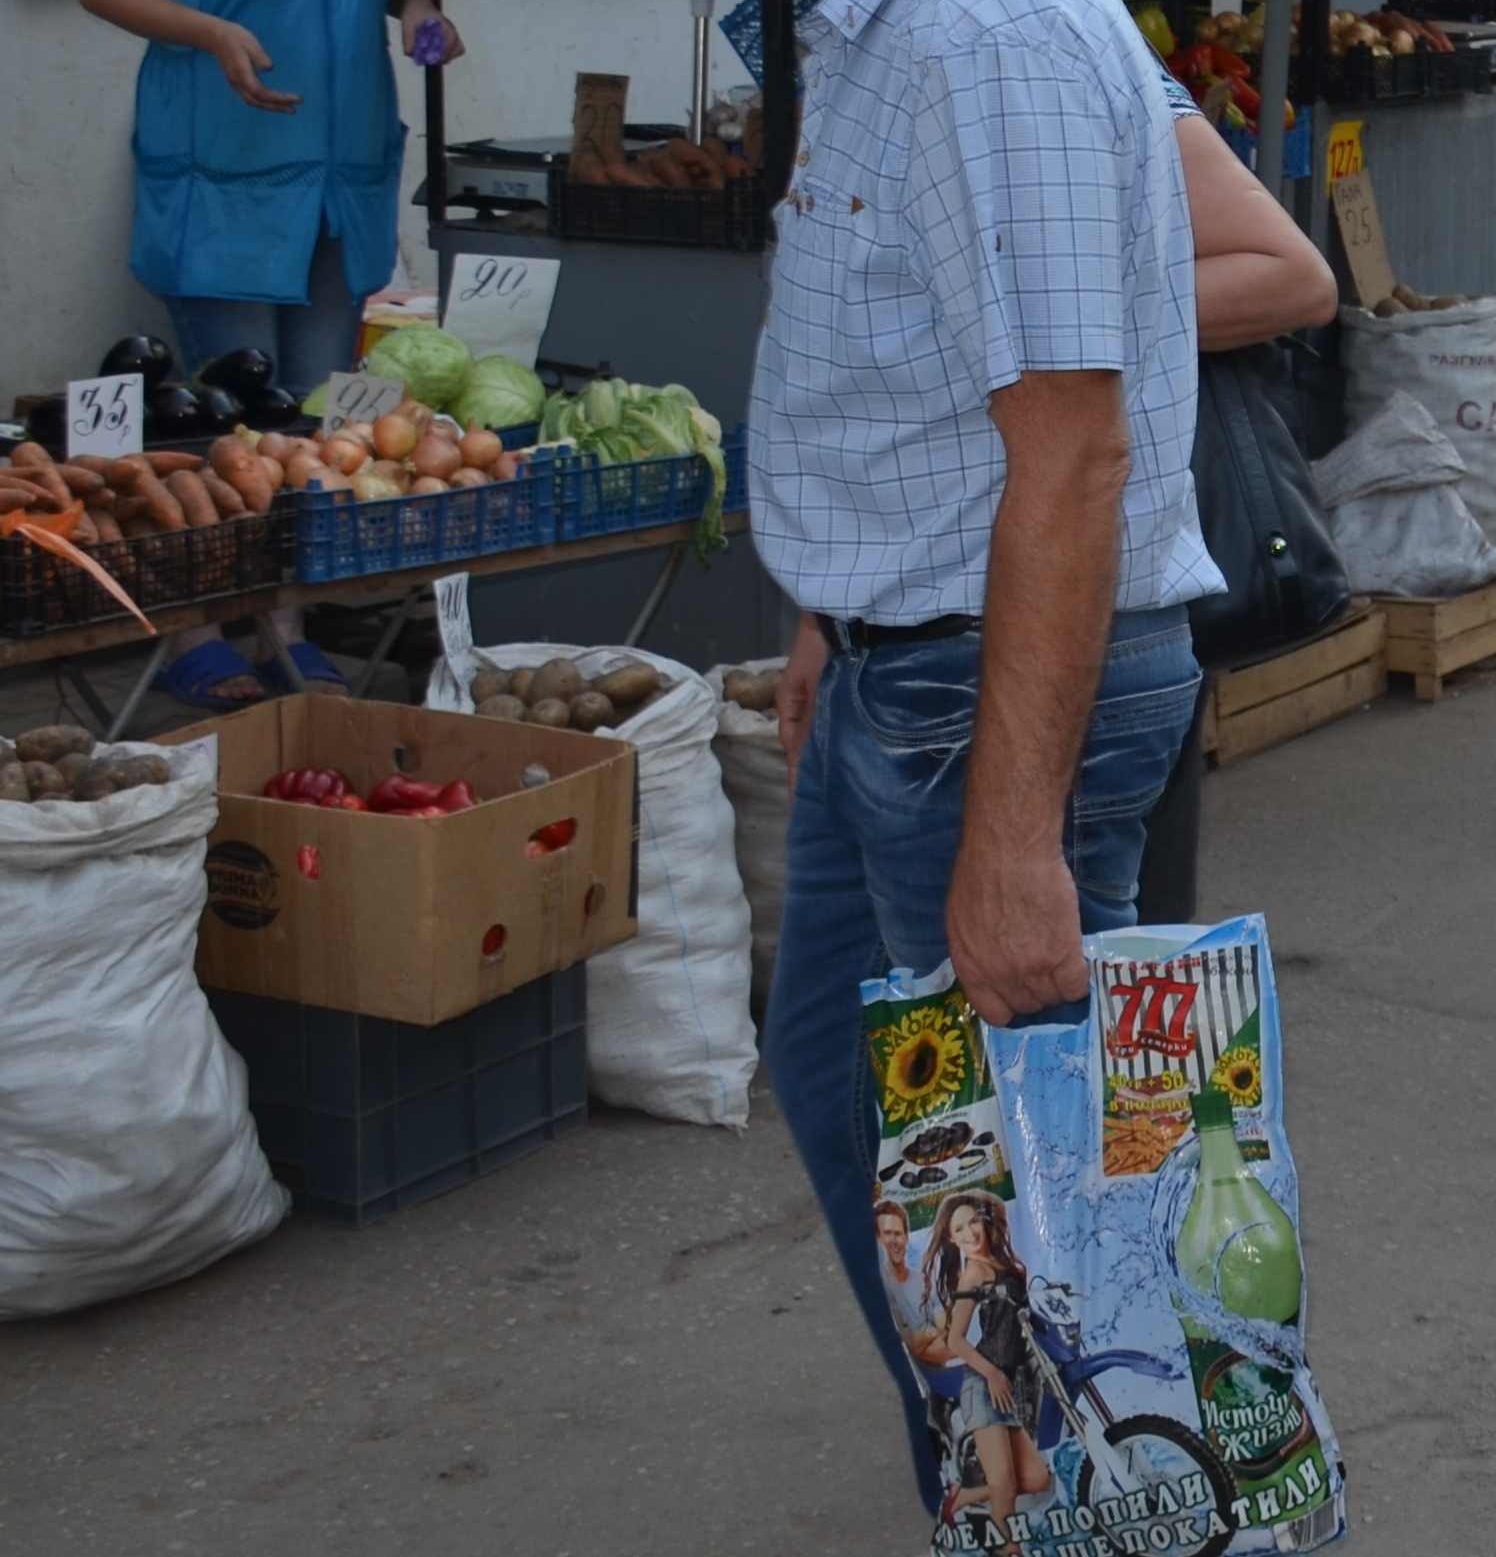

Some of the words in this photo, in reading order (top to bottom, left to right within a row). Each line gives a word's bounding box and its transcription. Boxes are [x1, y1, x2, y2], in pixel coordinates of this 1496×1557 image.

[1110, 974, 1199, 1046] 777
[1163, 1071, 1186, 1089] 50
[1047, 1472, 1208, 1537] ПОПИЛИ
